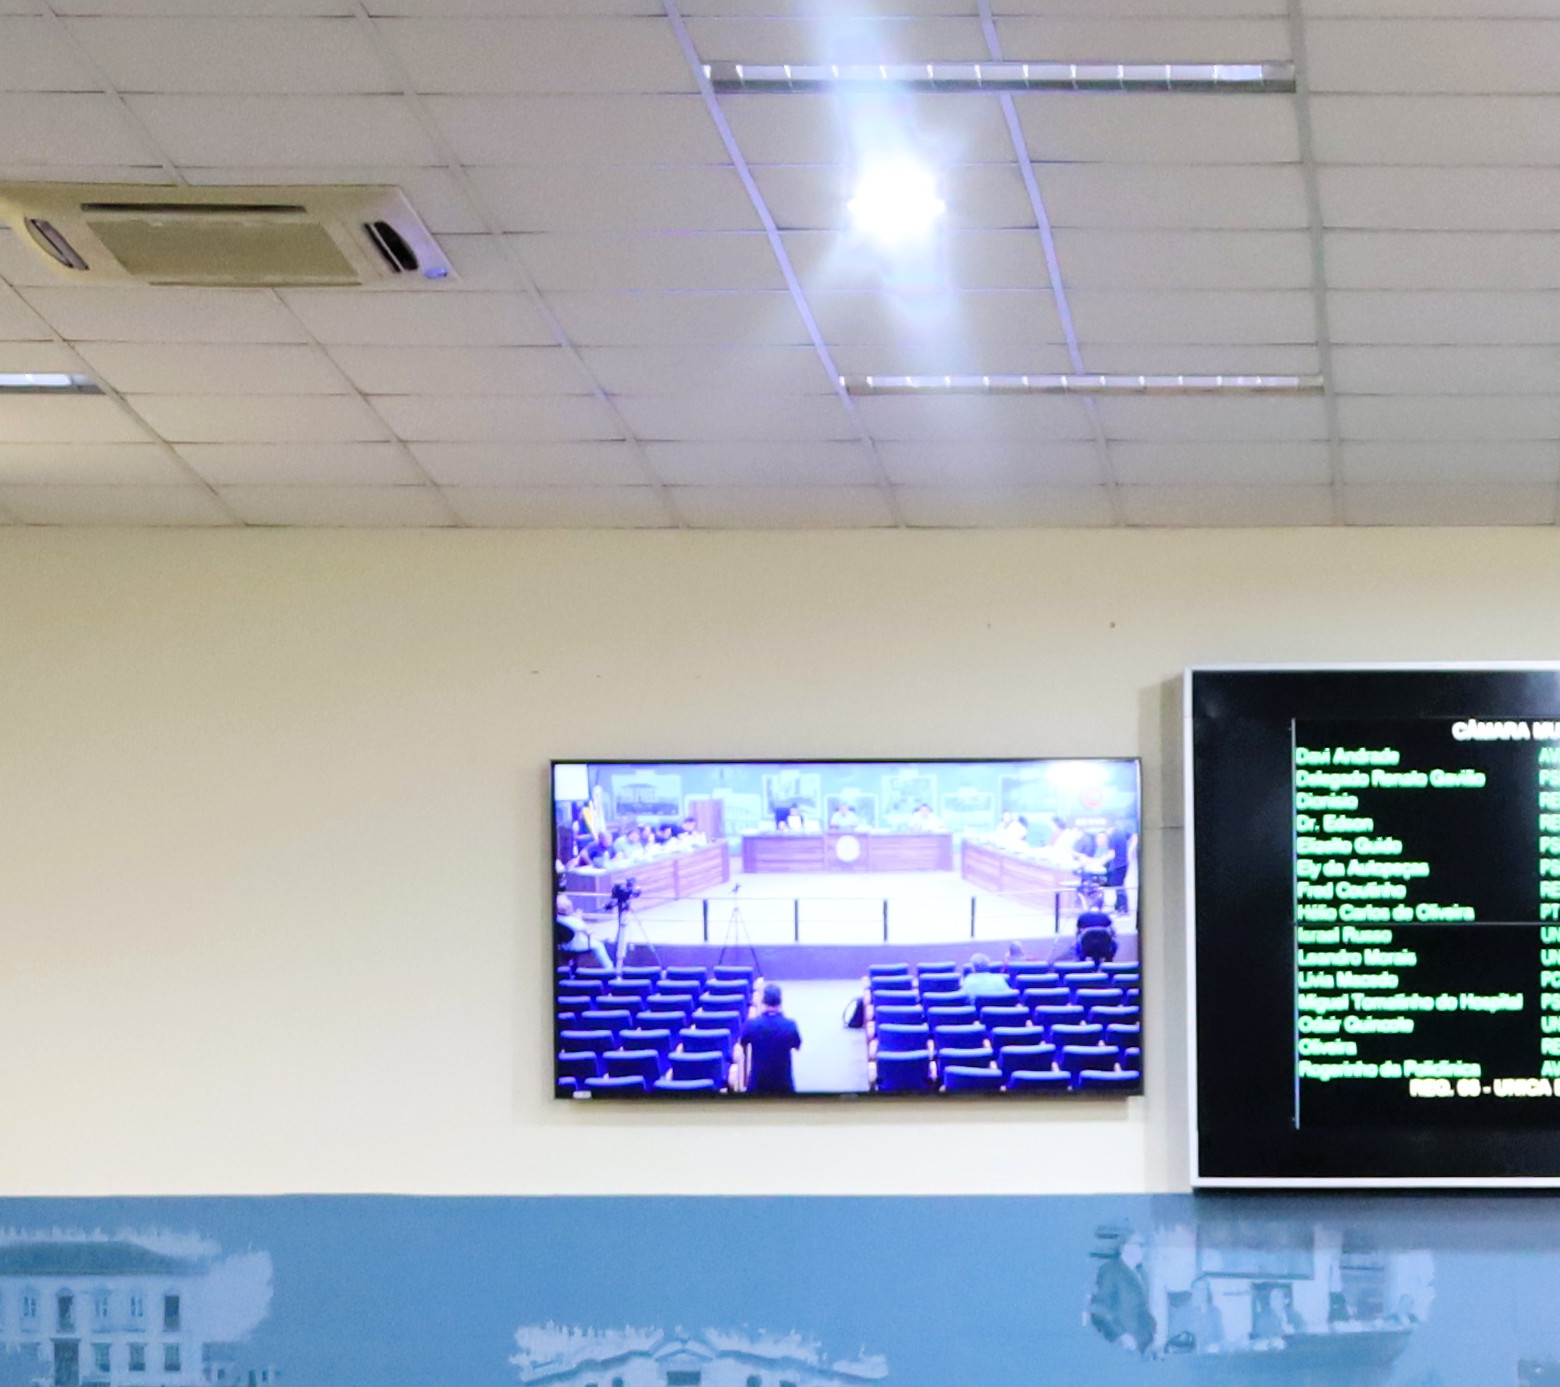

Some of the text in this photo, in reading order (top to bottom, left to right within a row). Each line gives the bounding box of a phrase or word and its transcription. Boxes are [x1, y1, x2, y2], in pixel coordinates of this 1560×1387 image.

[1451, 718, 1530, 741] CÂMARA
[1296, 814, 1320, 833] Dr.
[1539, 902, 1560, 920] PT
